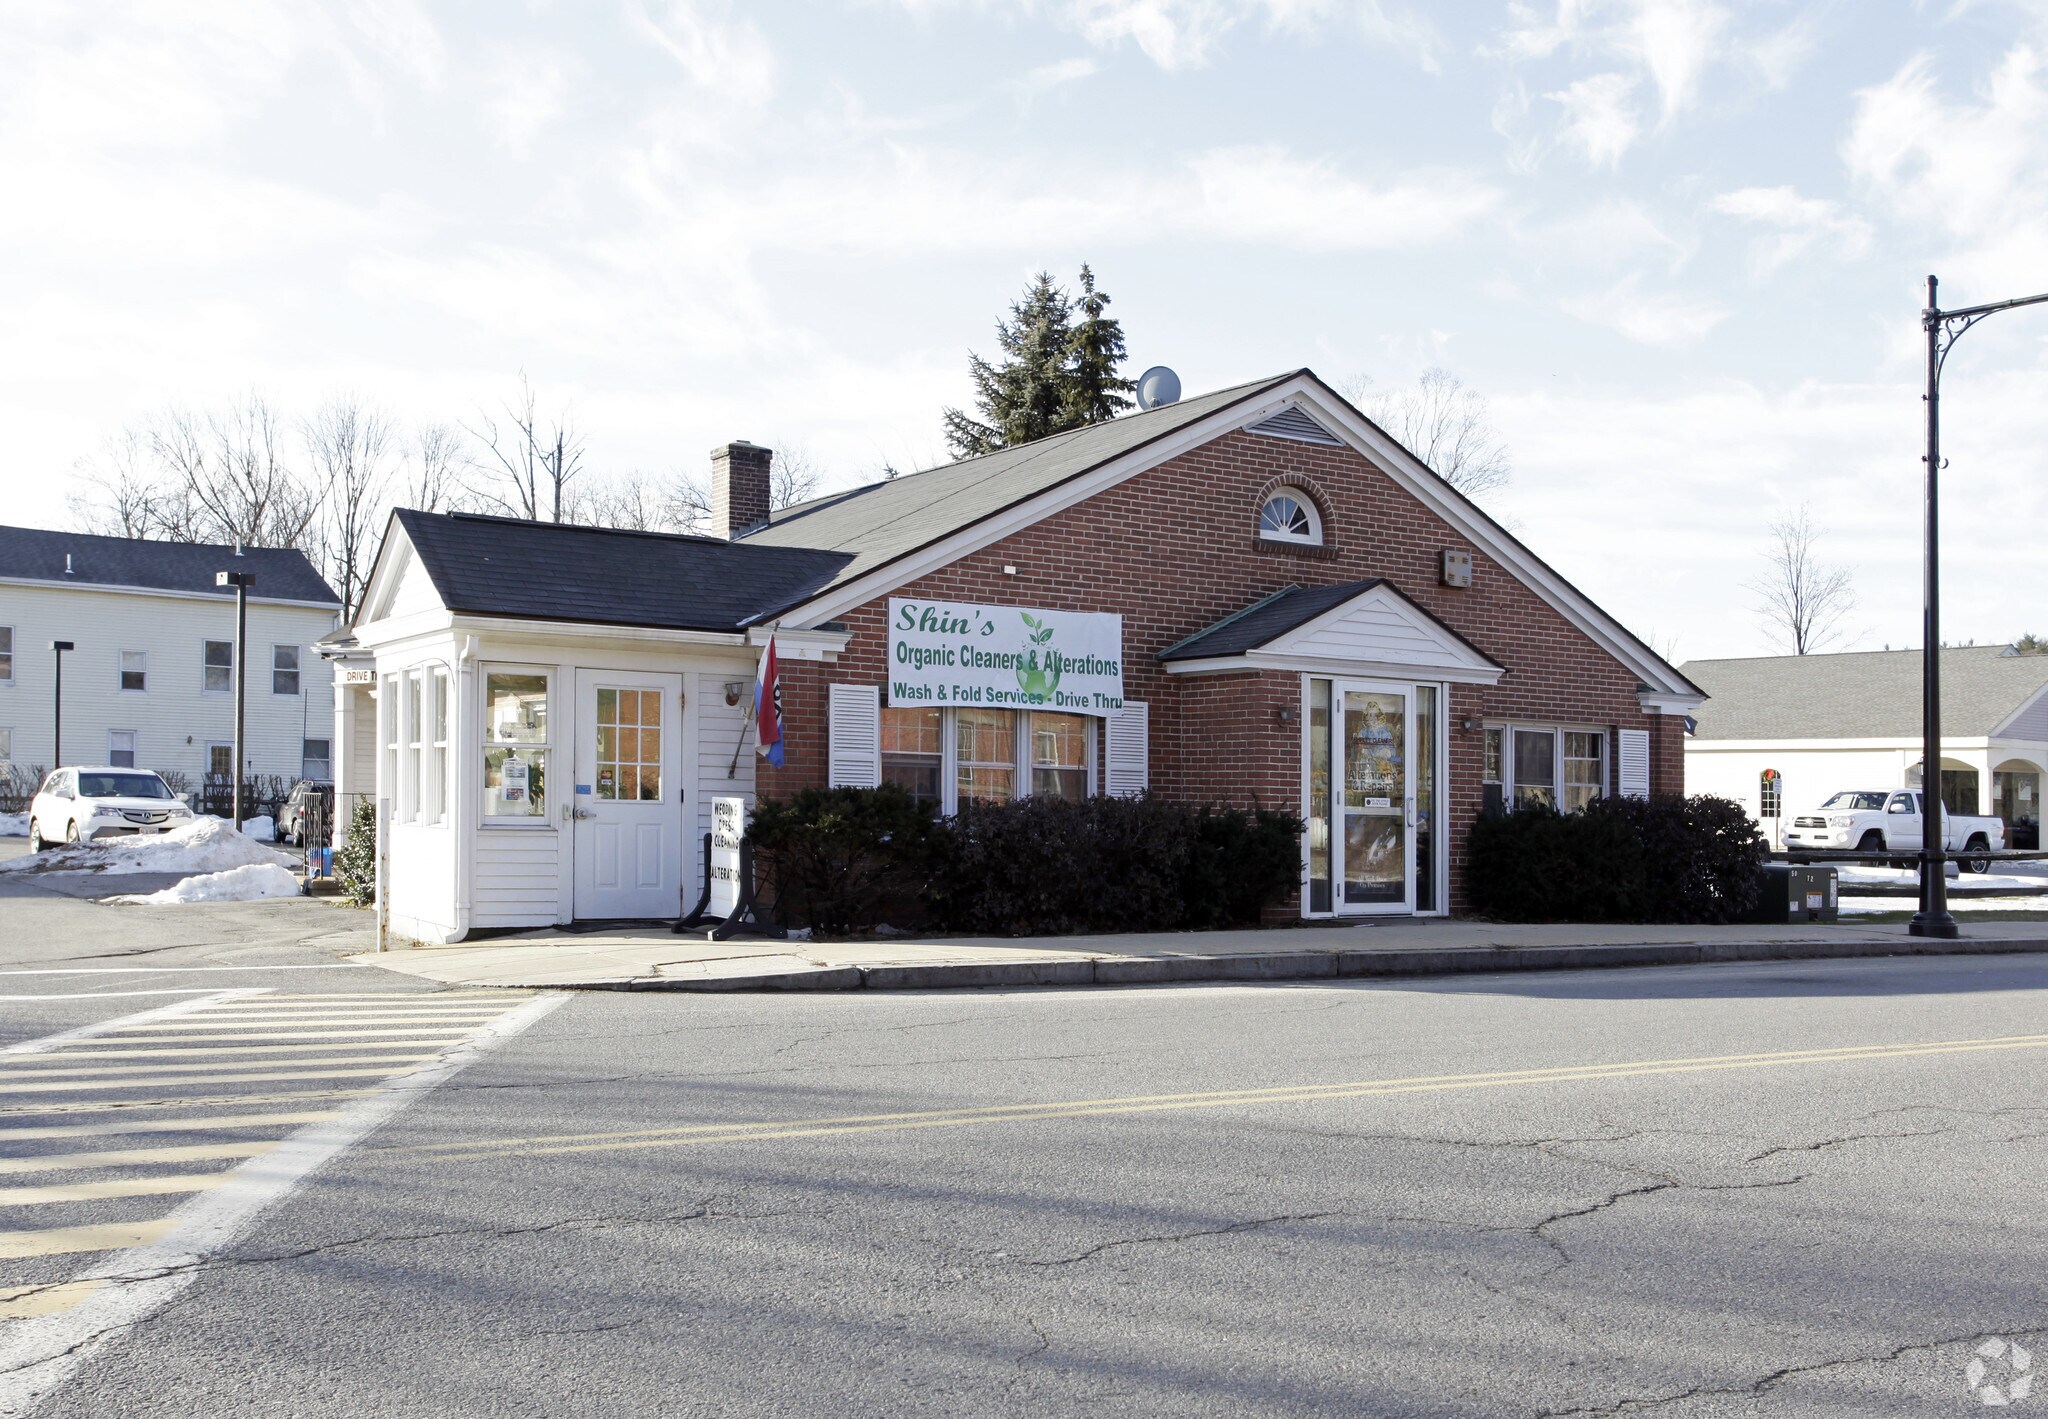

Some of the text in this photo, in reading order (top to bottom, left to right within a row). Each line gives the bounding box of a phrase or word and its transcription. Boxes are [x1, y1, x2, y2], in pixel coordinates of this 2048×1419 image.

[895, 604, 995, 636] Shin's
[896, 641, 1119, 677] Organic Cleaners & Alterations
[347, 671, 368, 682] DRIVE
[893, 682, 932, 700] Wash
[937, 684, 948, 700] &
[952, 685, 982, 702] Fold
[986, 686, 1044, 705] Services
[1055, 690, 1089, 708] Drive
[1093, 692, 1123, 709] Thru
[1360, 780, 1393, 794] Repairs
[714, 834, 739, 850] CLEANING
[710, 866, 741, 882] ALTERATON
